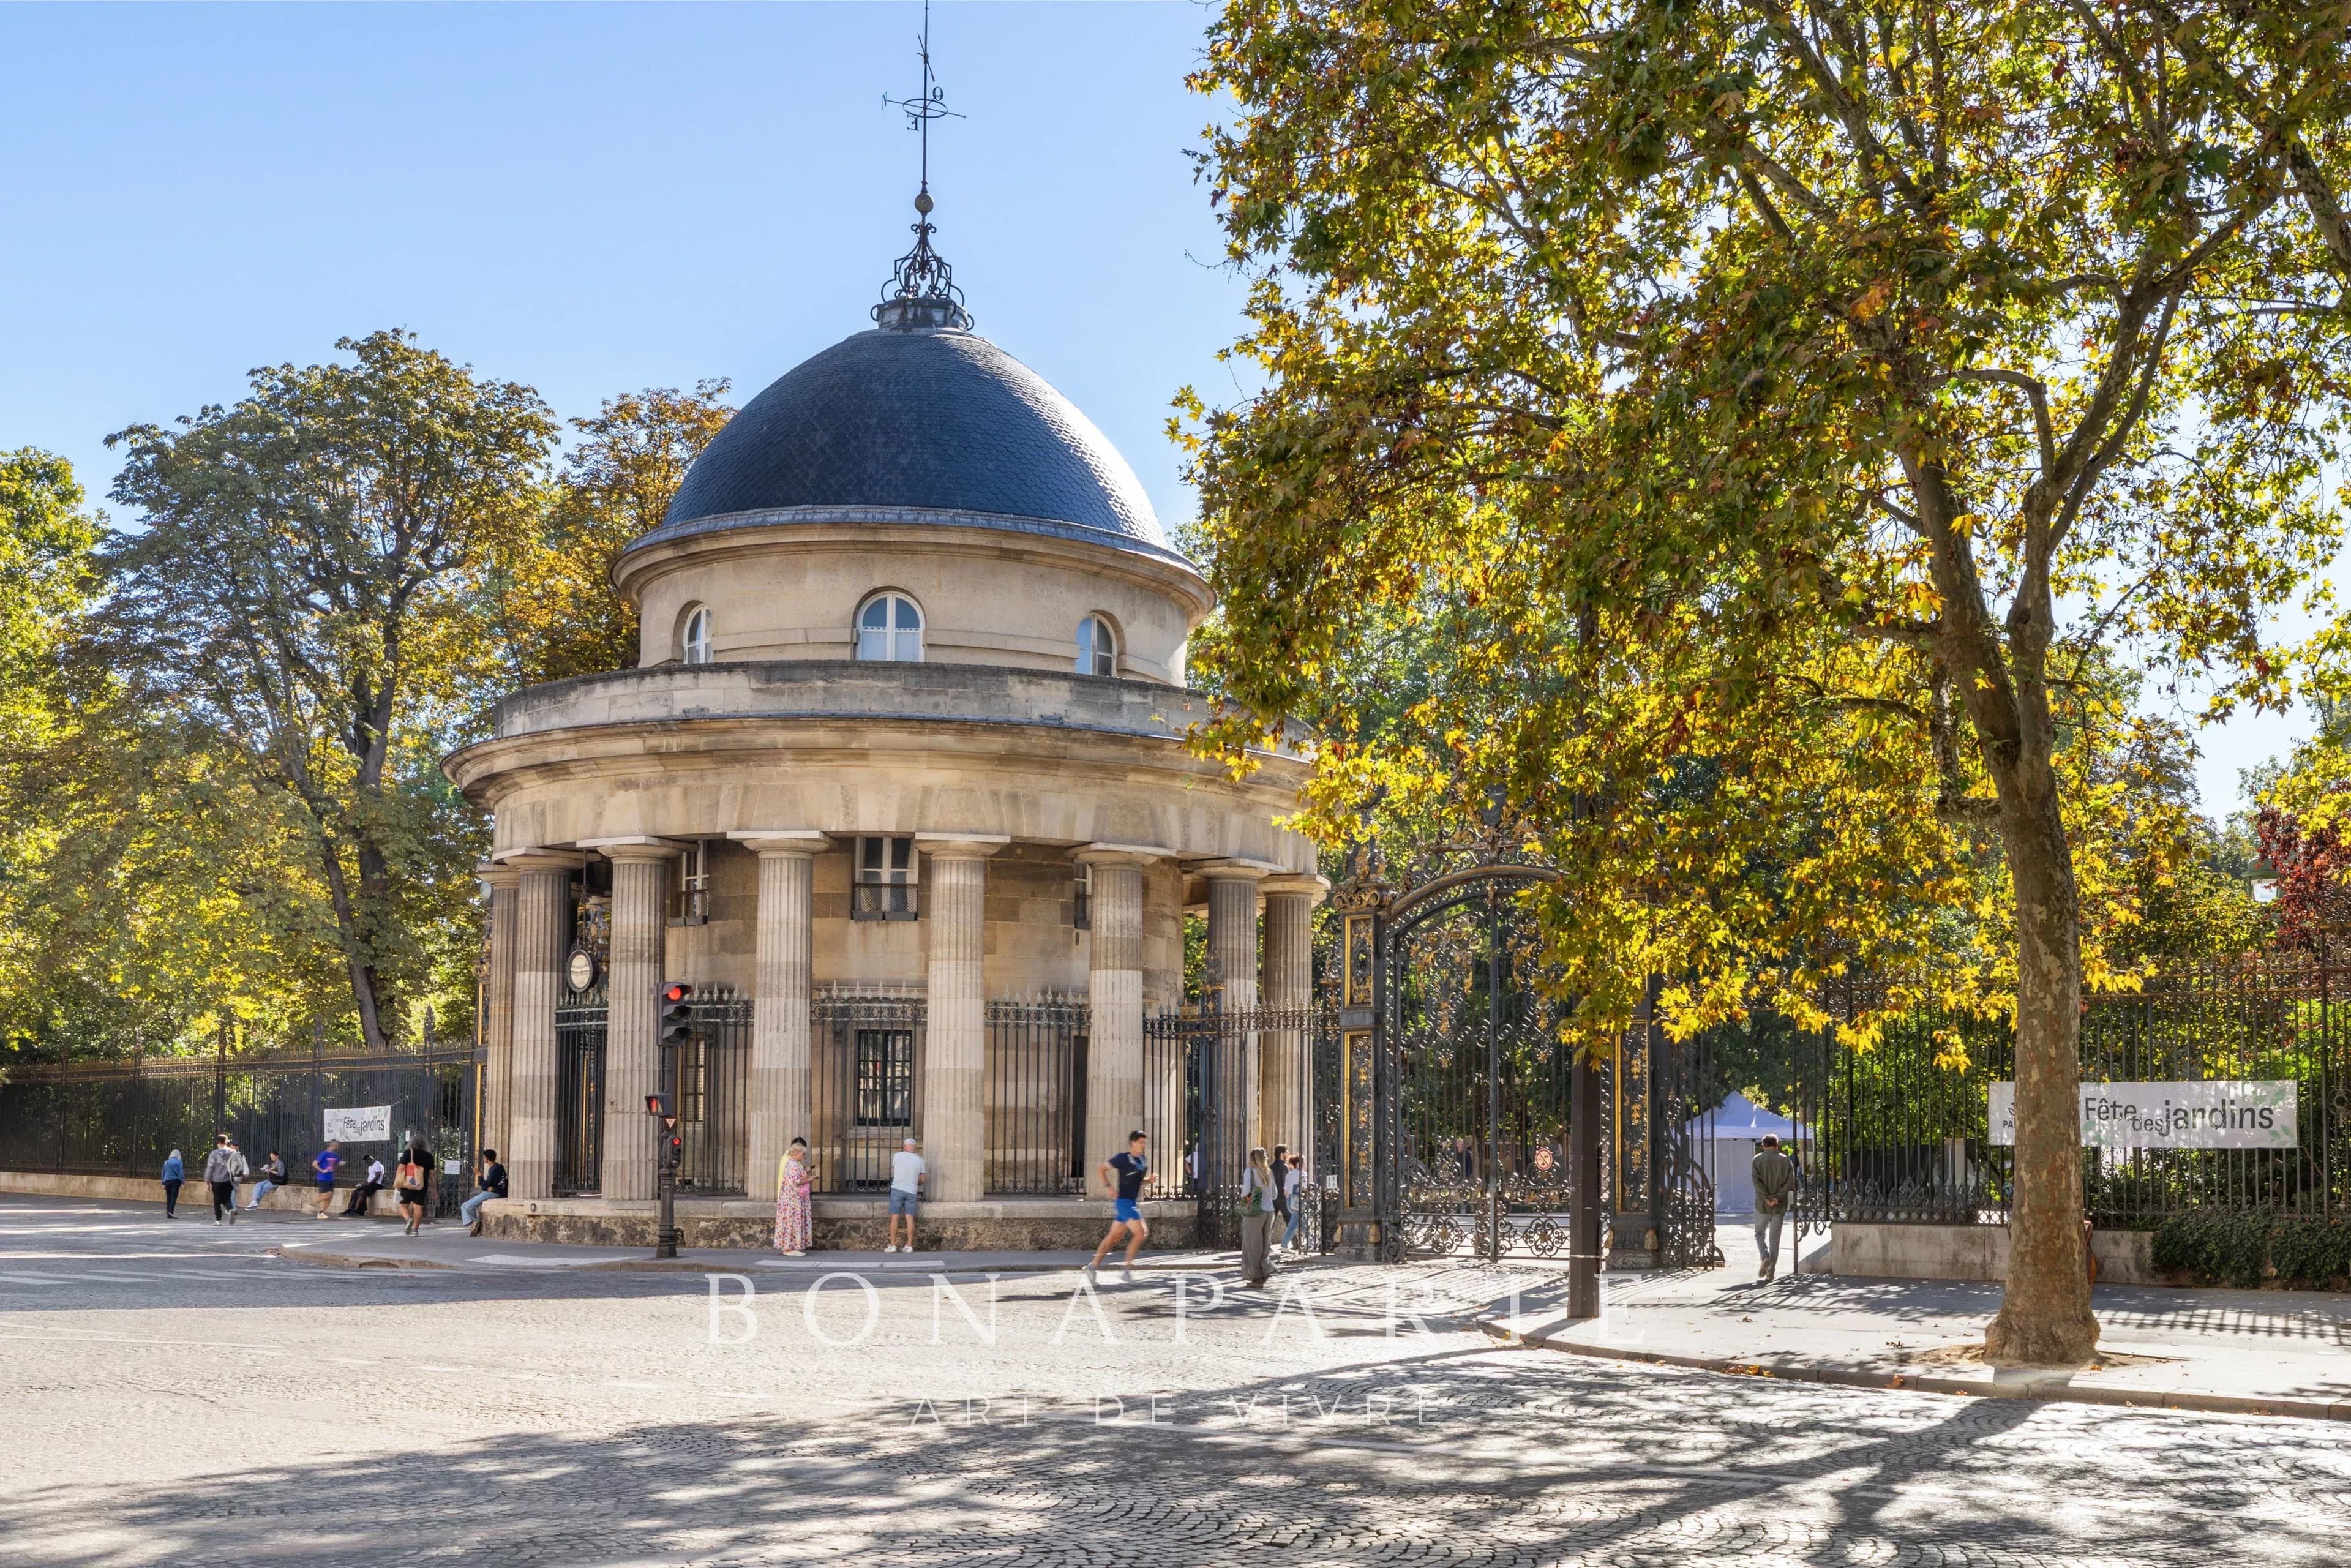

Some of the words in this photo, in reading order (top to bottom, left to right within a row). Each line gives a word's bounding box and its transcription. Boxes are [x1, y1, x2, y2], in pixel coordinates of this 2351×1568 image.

[343, 1116, 356, 1129] Fête
[359, 1116, 384, 1136] jardins
[2085, 1098, 2137, 1121] Fête
[2132, 1113, 2163, 1131] des
[2158, 1099, 2274, 1137] jardins
